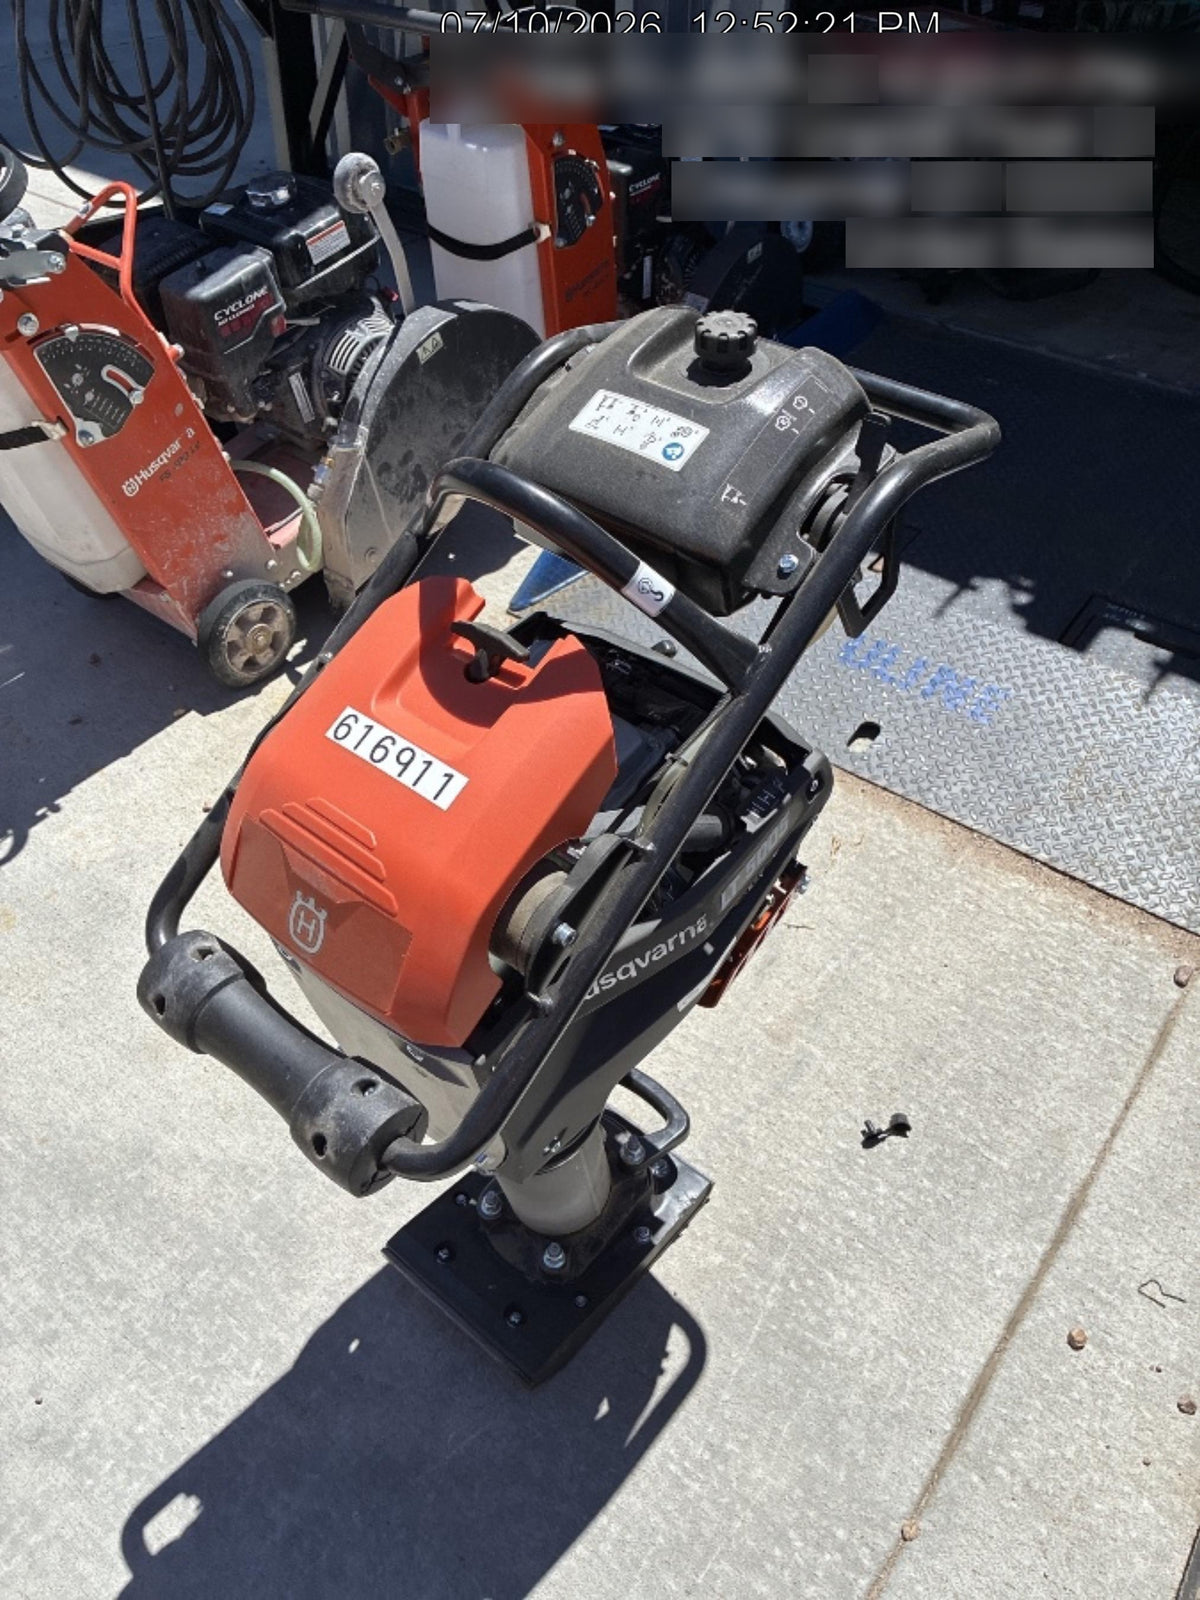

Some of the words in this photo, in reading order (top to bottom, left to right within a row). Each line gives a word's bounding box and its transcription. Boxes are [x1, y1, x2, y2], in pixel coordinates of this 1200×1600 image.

[214, 284, 268, 321] CYCLONE
[134, 427, 196, 487] Husqvara
[333, 713, 454, 801] 616911
[583, 914, 708, 1000] usqvarna
